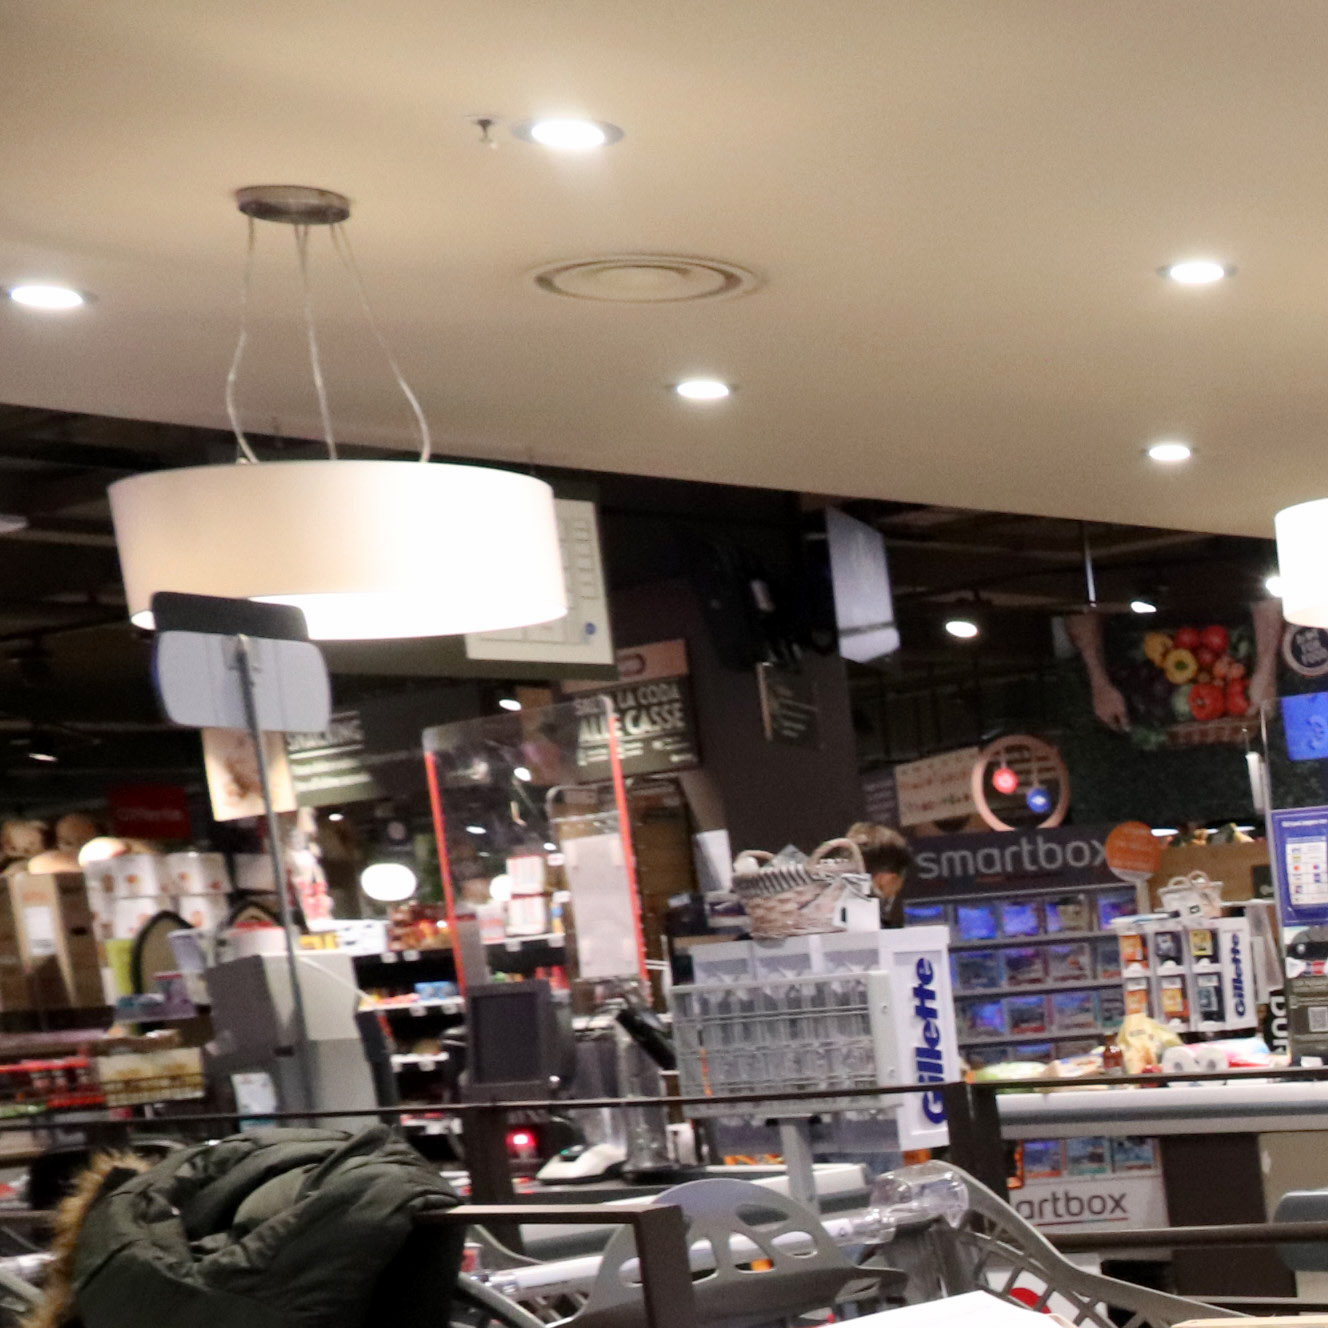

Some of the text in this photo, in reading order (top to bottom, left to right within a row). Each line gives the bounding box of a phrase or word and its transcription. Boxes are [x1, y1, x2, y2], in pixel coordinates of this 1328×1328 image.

[916, 836, 1106, 880] smartbox
[1229, 933, 1247, 1018] Gillette
[912, 957, 948, 1125] Gillette
